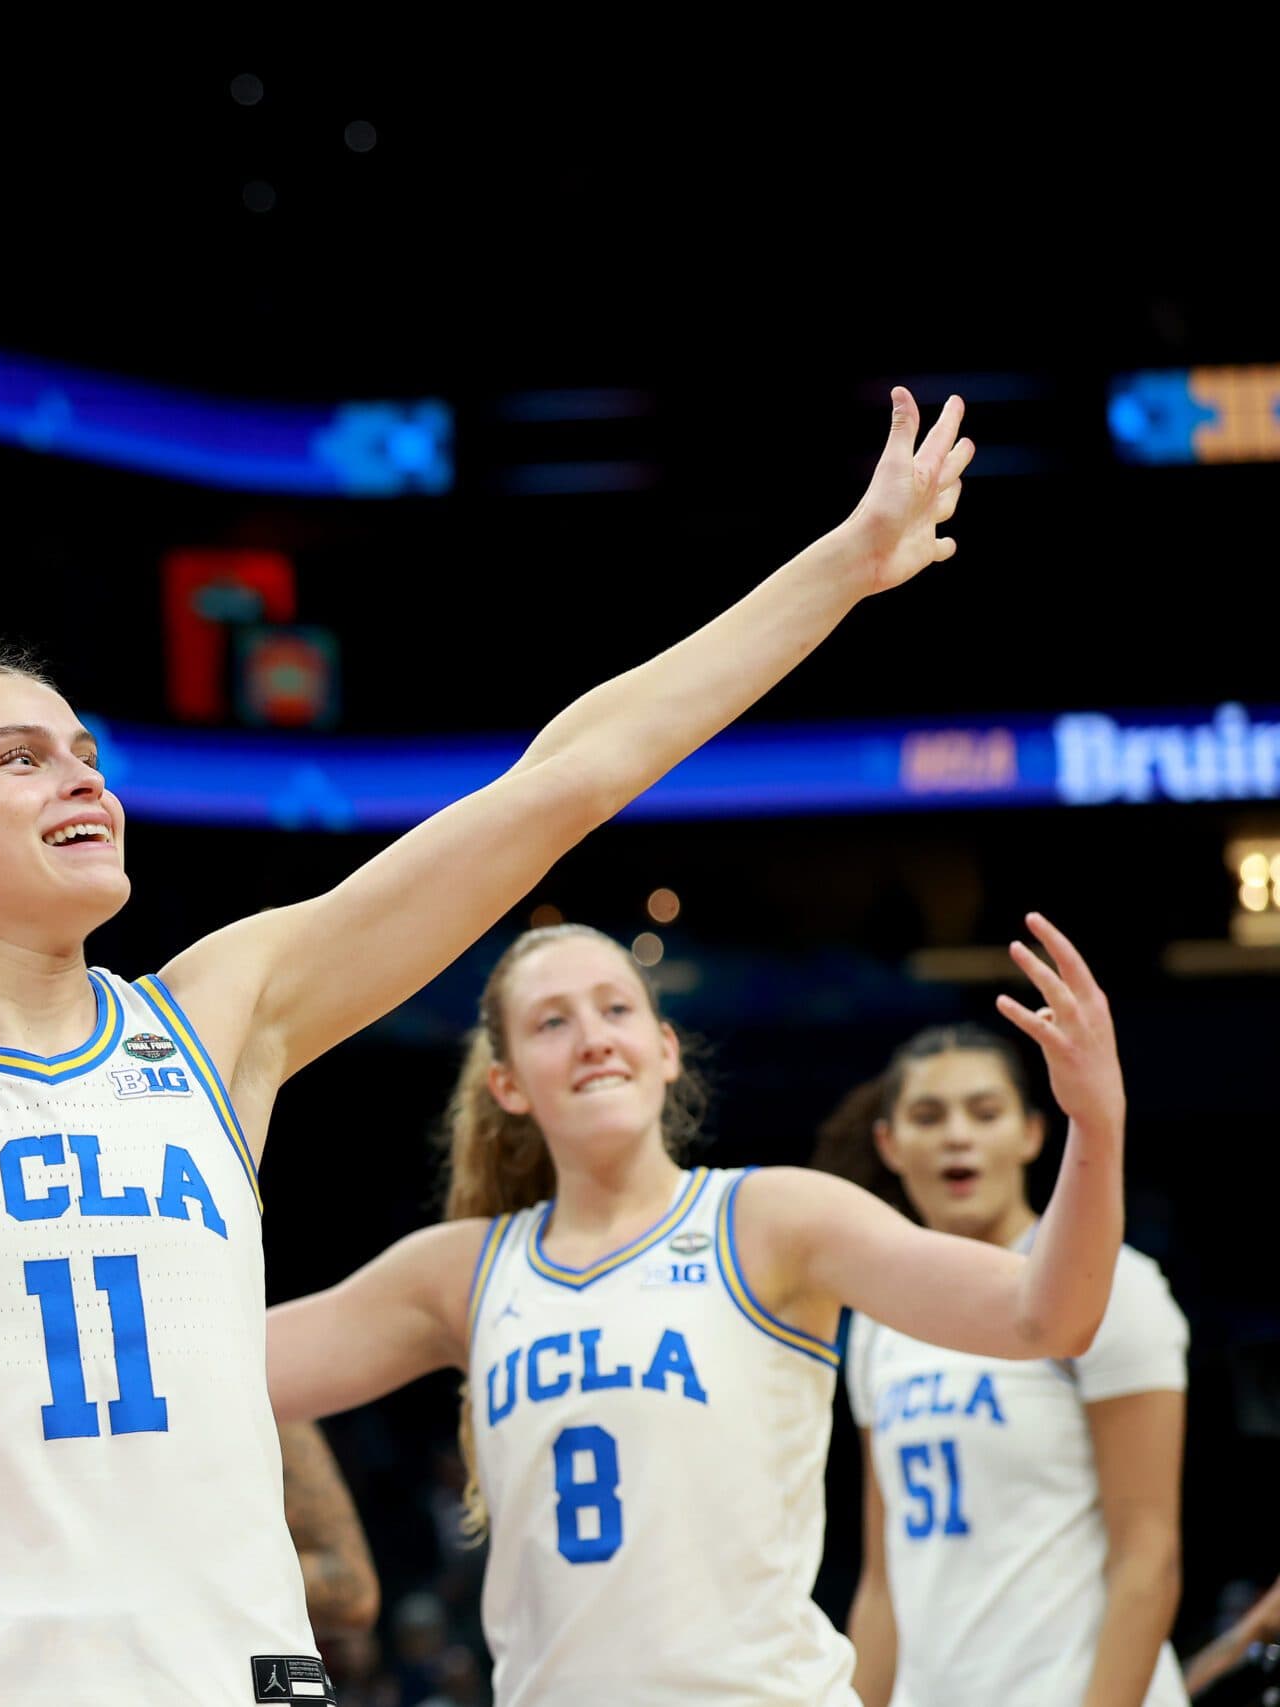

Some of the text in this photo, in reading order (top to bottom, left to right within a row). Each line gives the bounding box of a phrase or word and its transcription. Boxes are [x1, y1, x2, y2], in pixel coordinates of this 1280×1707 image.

[126, 1041, 174, 1051] FINAL FOUR
[23, 1254, 169, 1441] 11
[487, 1328, 708, 1427] UCLA
[876, 1371, 1006, 1433] UCLA
[552, 1424, 624, 1565] 8
[898, 1438, 970, 1538] 51
